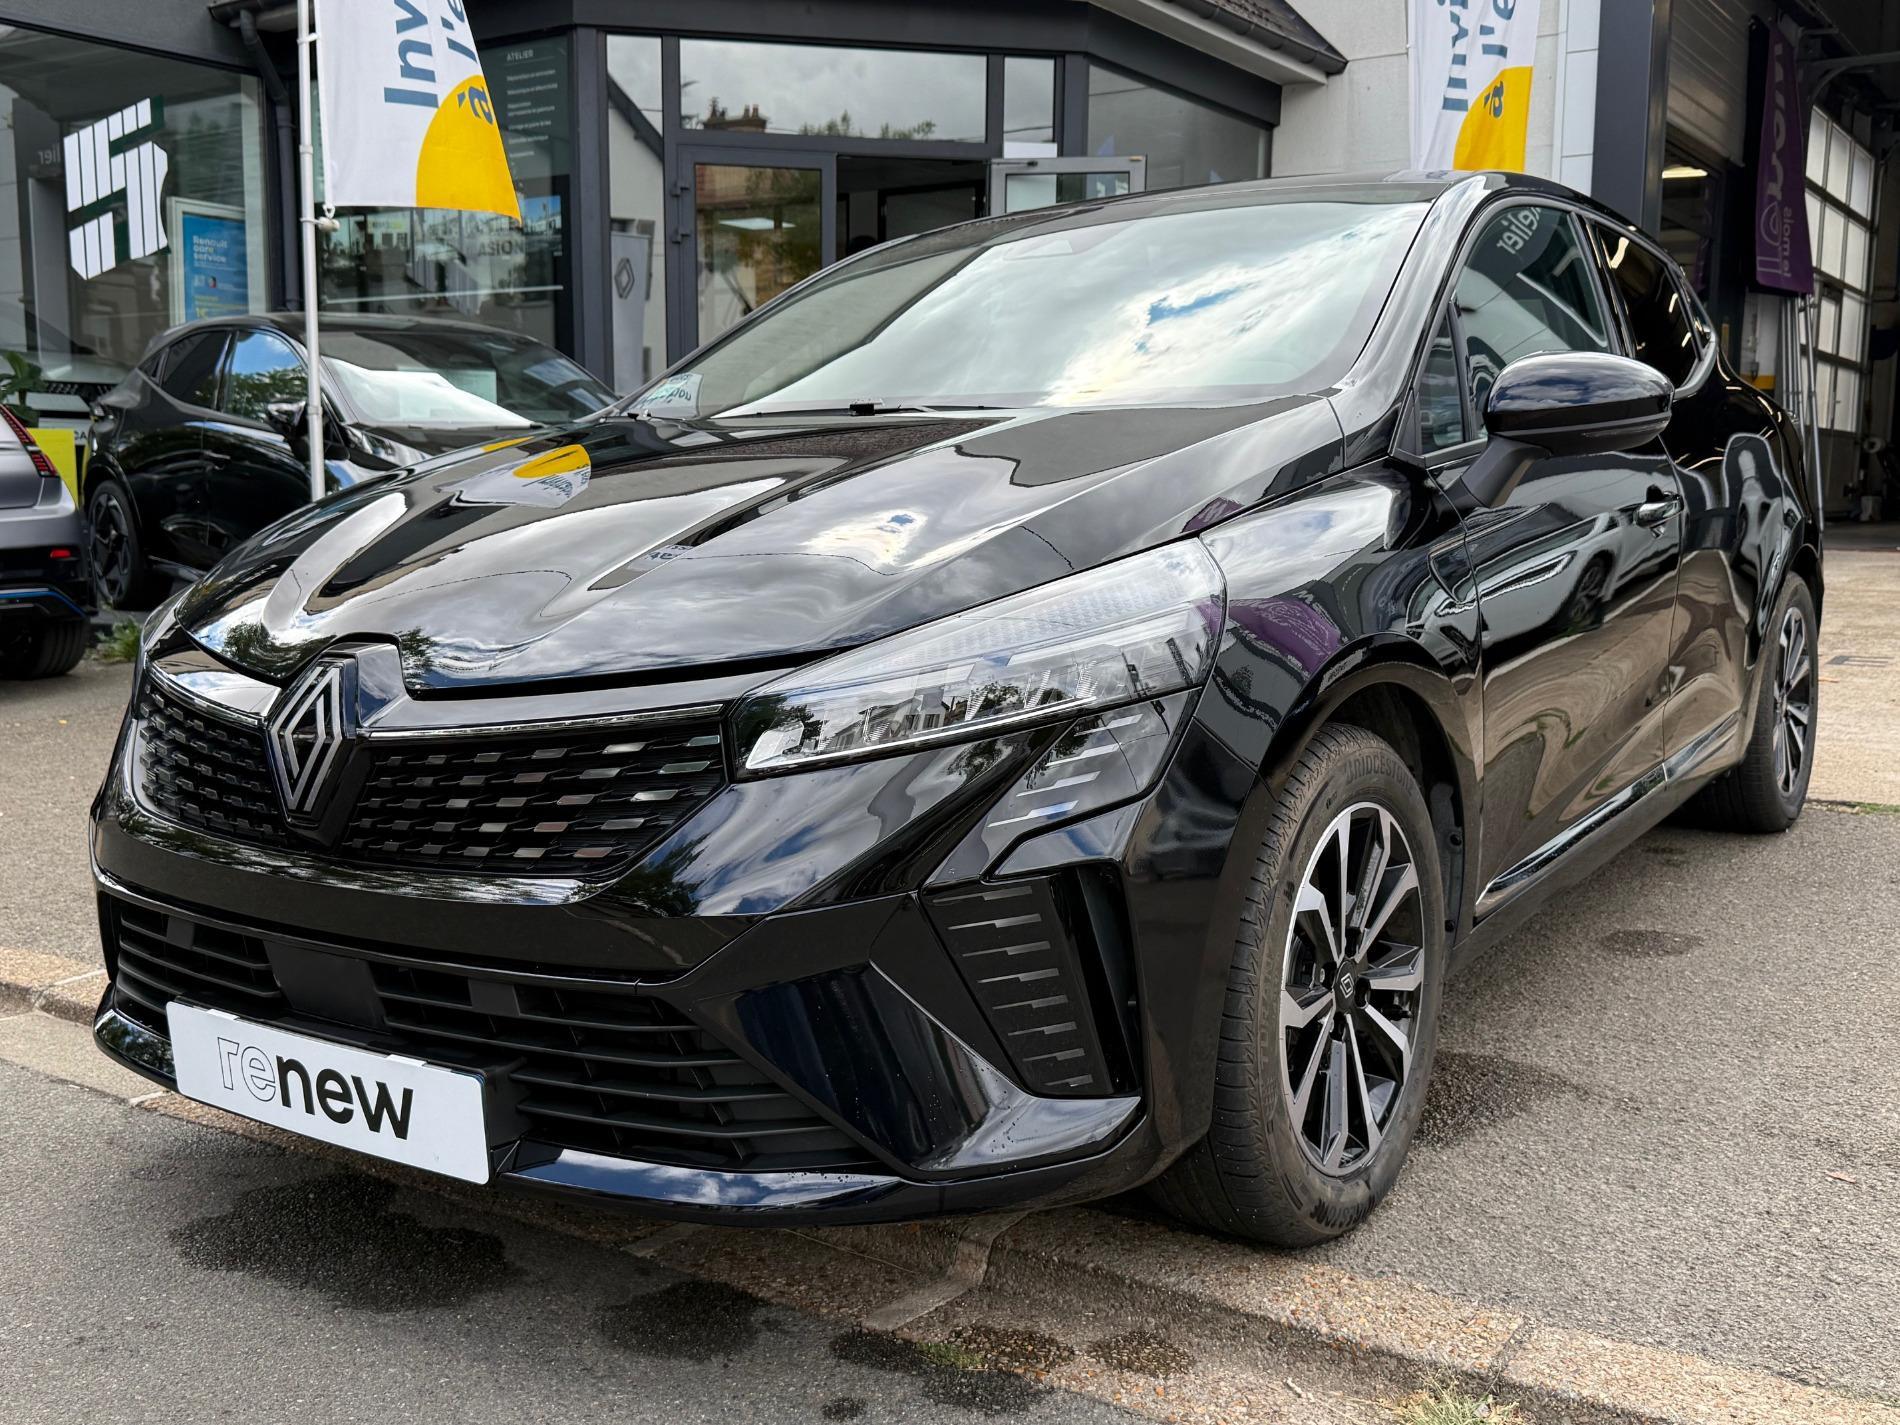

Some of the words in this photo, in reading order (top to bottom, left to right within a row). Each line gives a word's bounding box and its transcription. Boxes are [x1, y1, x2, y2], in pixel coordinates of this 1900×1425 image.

[506, 49, 533, 62] ATELIER
[457, 86, 494, 125] à
[217, 1036, 414, 1140] renew
